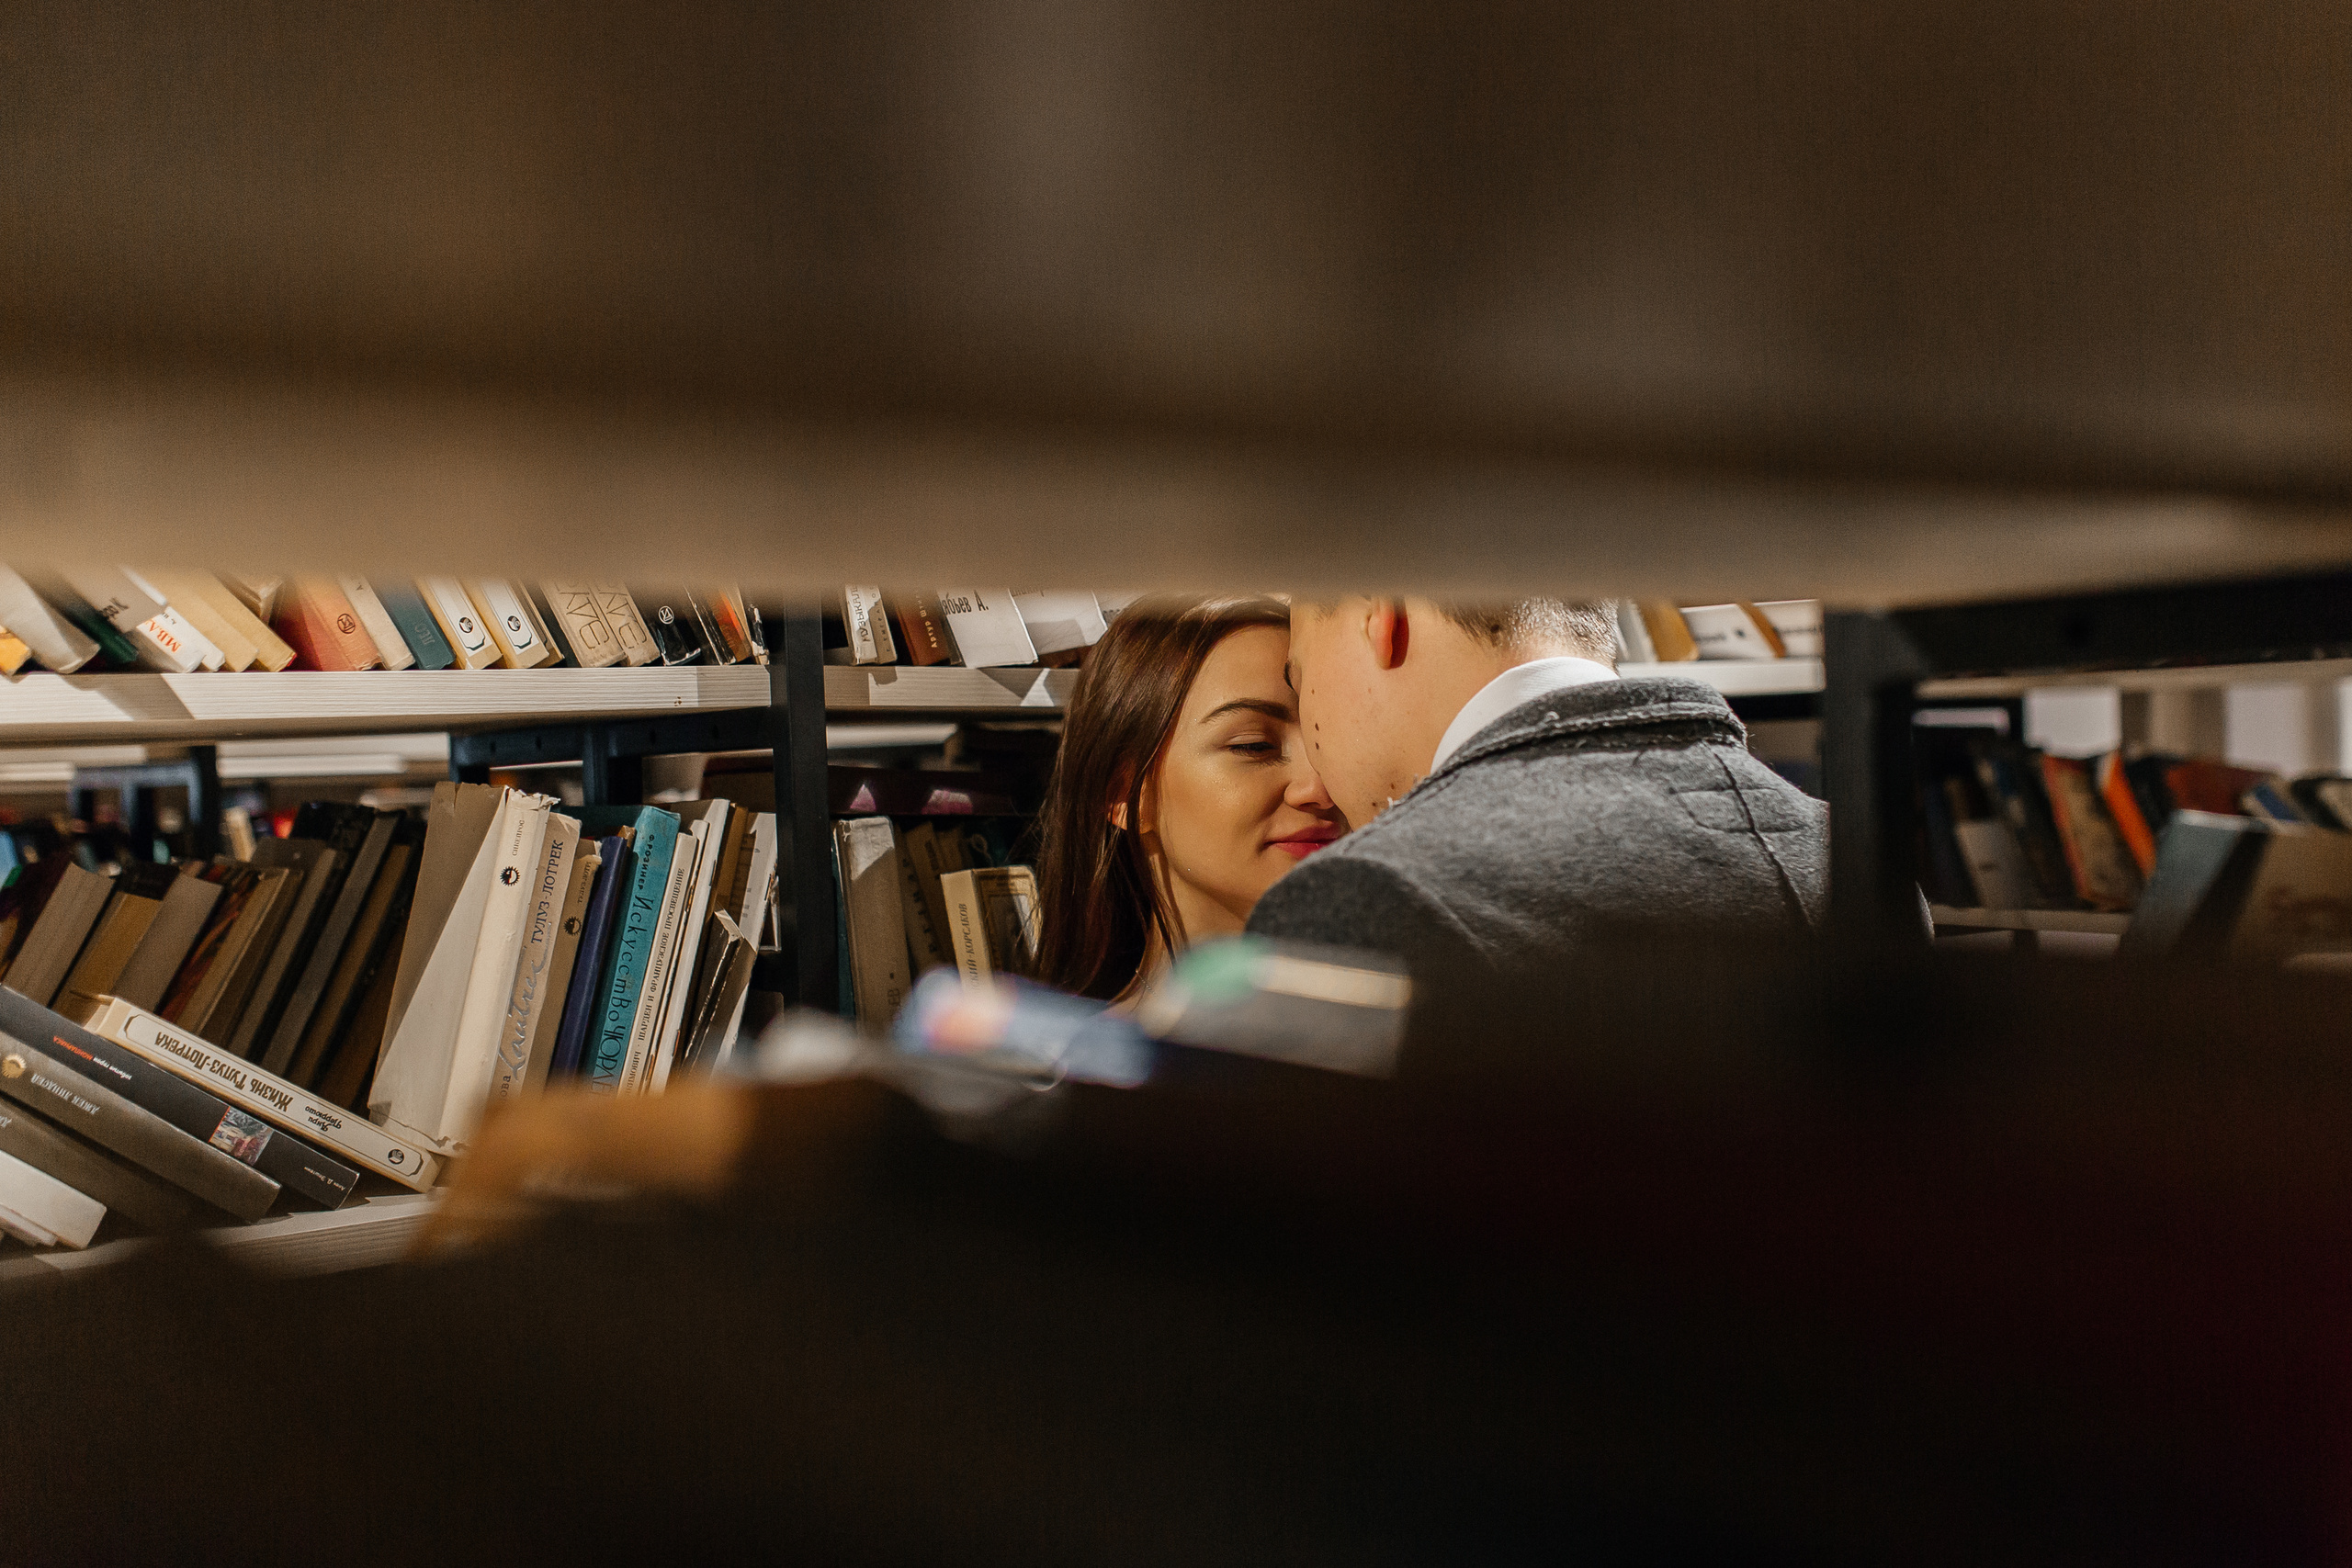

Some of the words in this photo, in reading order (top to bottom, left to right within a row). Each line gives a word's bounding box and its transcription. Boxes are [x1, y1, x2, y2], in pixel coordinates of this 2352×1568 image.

[564, 592, 610, 650] ЭДУ
[605, 592, 647, 650] ЭДУ
[941, 591, 971, 614] ябьев
[973, 588, 989, 611] А.
[924, 620, 938, 648] Артур
[530, 840, 563, 944] ТУЛУЗ-ЛОТРЕК
[637, 1004, 653, 1041] ШАРДЕН
[648, 931, 671, 993] ФРАНЦУЗСКОЕ
[663, 867, 685, 930] ПРОСВЕЩЕНИЕ
[500, 1075, 510, 1097] ова
